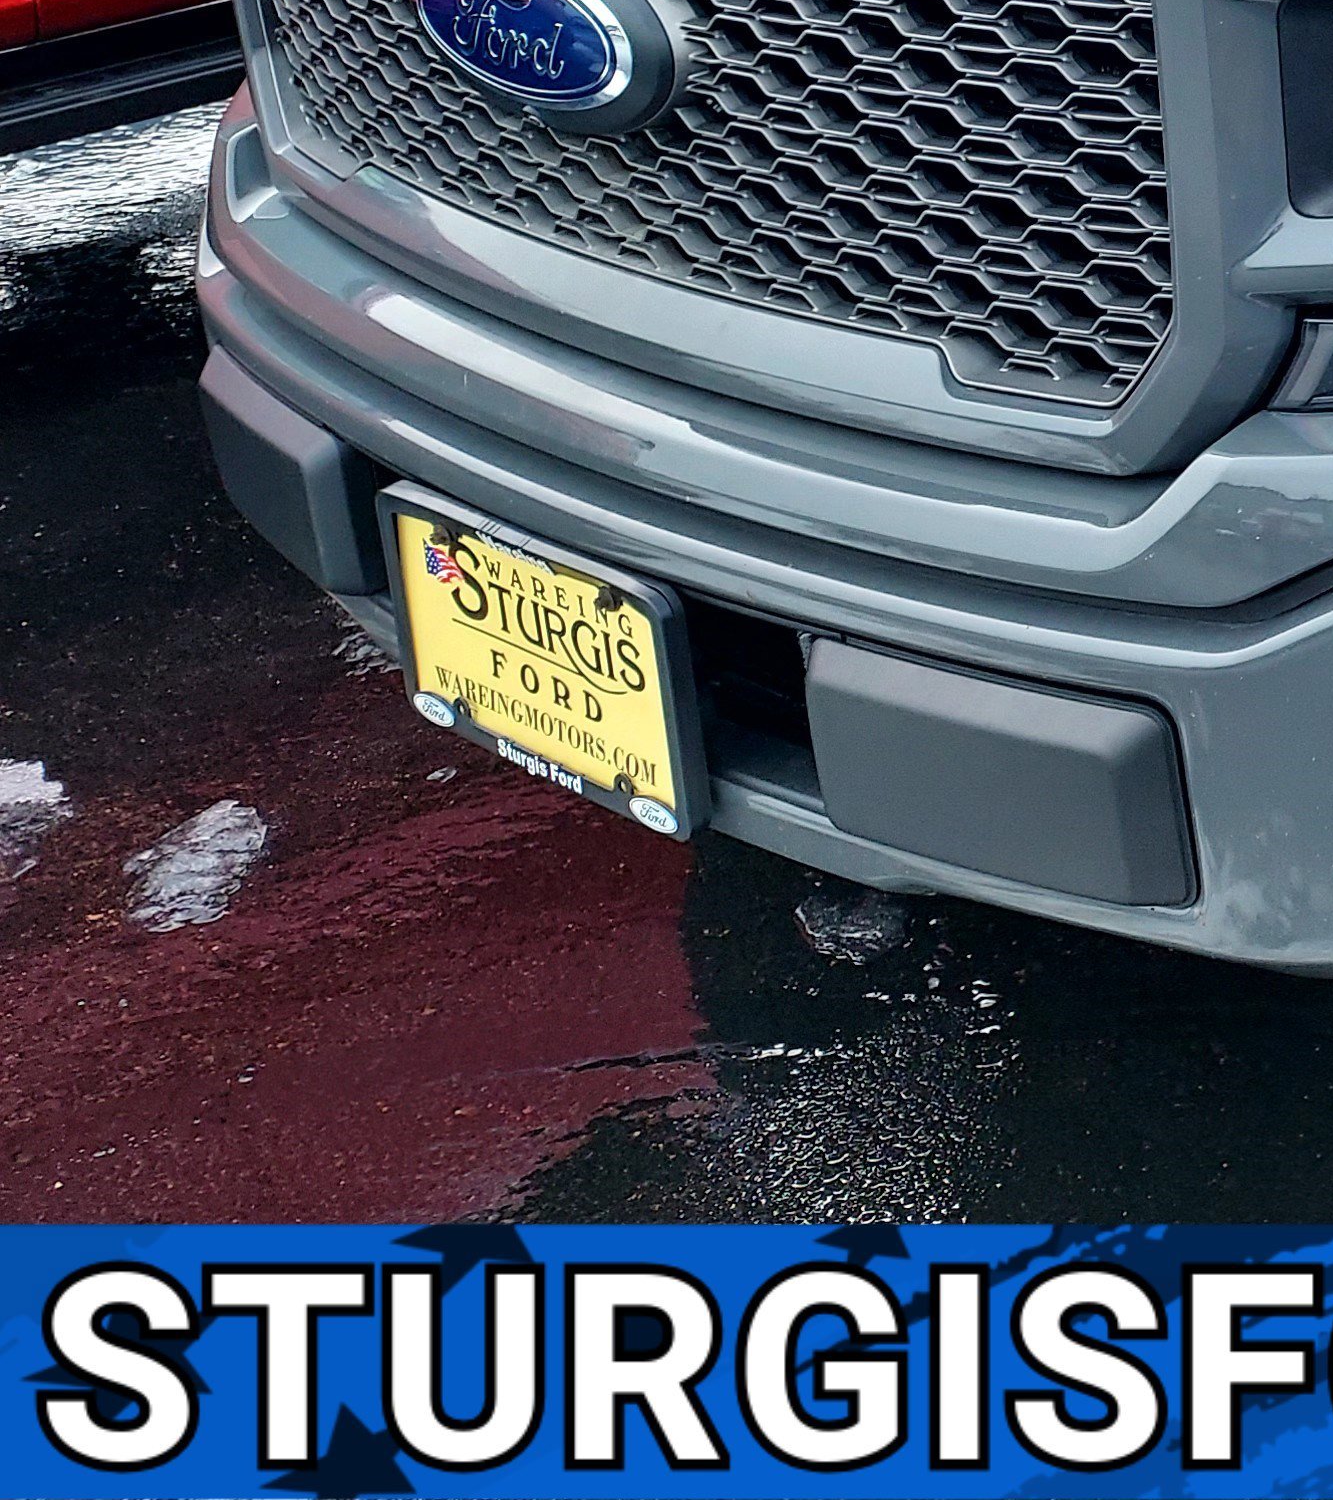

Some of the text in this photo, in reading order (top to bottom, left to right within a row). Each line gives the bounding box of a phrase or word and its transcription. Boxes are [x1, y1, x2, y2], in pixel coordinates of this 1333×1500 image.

[450, 540, 646, 694] STURGIS
[482, 554, 634, 638] WAREING
[421, 698, 447, 722] Ford
[490, 649, 604, 722] FORD
[435, 665, 657, 787] WAREINGMOTORS.COM
[497, 738, 583, 795] Sturgis Ford
[639, 802, 668, 829] Ford
